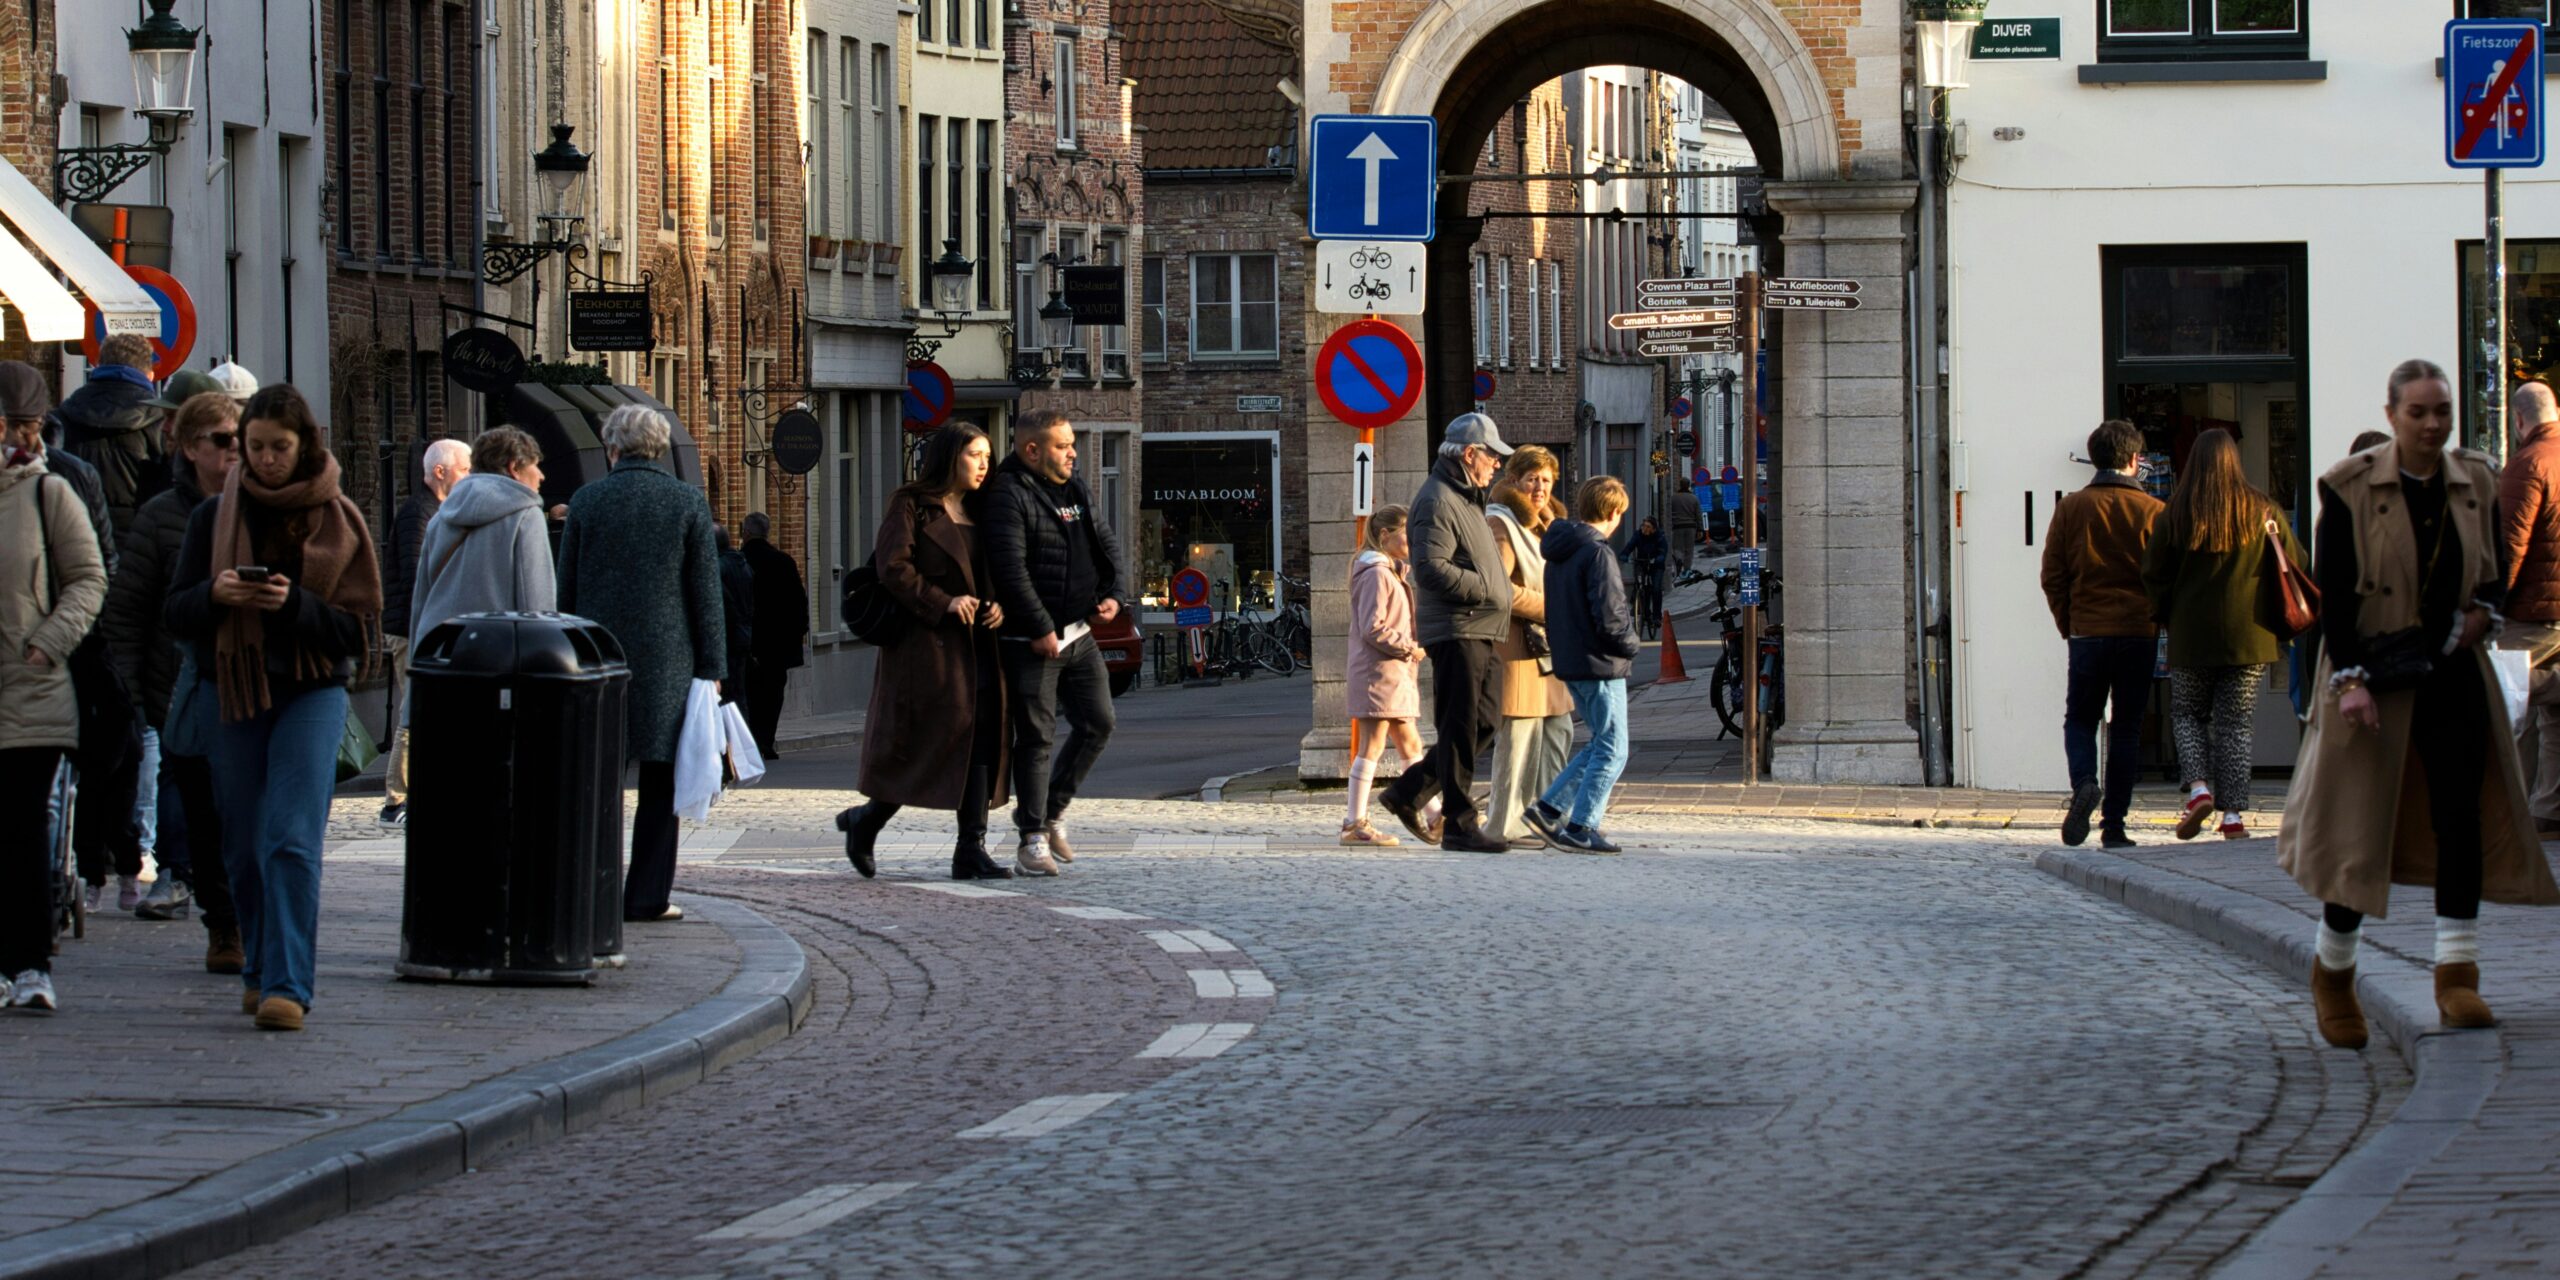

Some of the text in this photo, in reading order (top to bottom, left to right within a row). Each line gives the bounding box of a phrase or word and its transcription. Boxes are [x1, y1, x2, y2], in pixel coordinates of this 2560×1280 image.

[1992, 24, 2032, 37] DIJVER
[2462, 35, 2522, 49] Fietszon
[1995, 45, 2011, 53] oude
[2011, 45, 2046, 54] plaatsnaam
[1646, 280, 1709, 292] Crowne Plaza
[576, 298, 644, 309] EEKHOETJE
[1366, 300, 1373, 310] A
[1647, 297, 1688, 306] Botaniek
[1789, 297, 1846, 308] De Tuilerieën
[1661, 312, 1705, 324] Pandhotel
[1647, 328, 1693, 340] Malleberg
[1651, 343, 1688, 353] Patritius
[1153, 488, 1256, 501] LUNABLOOM
